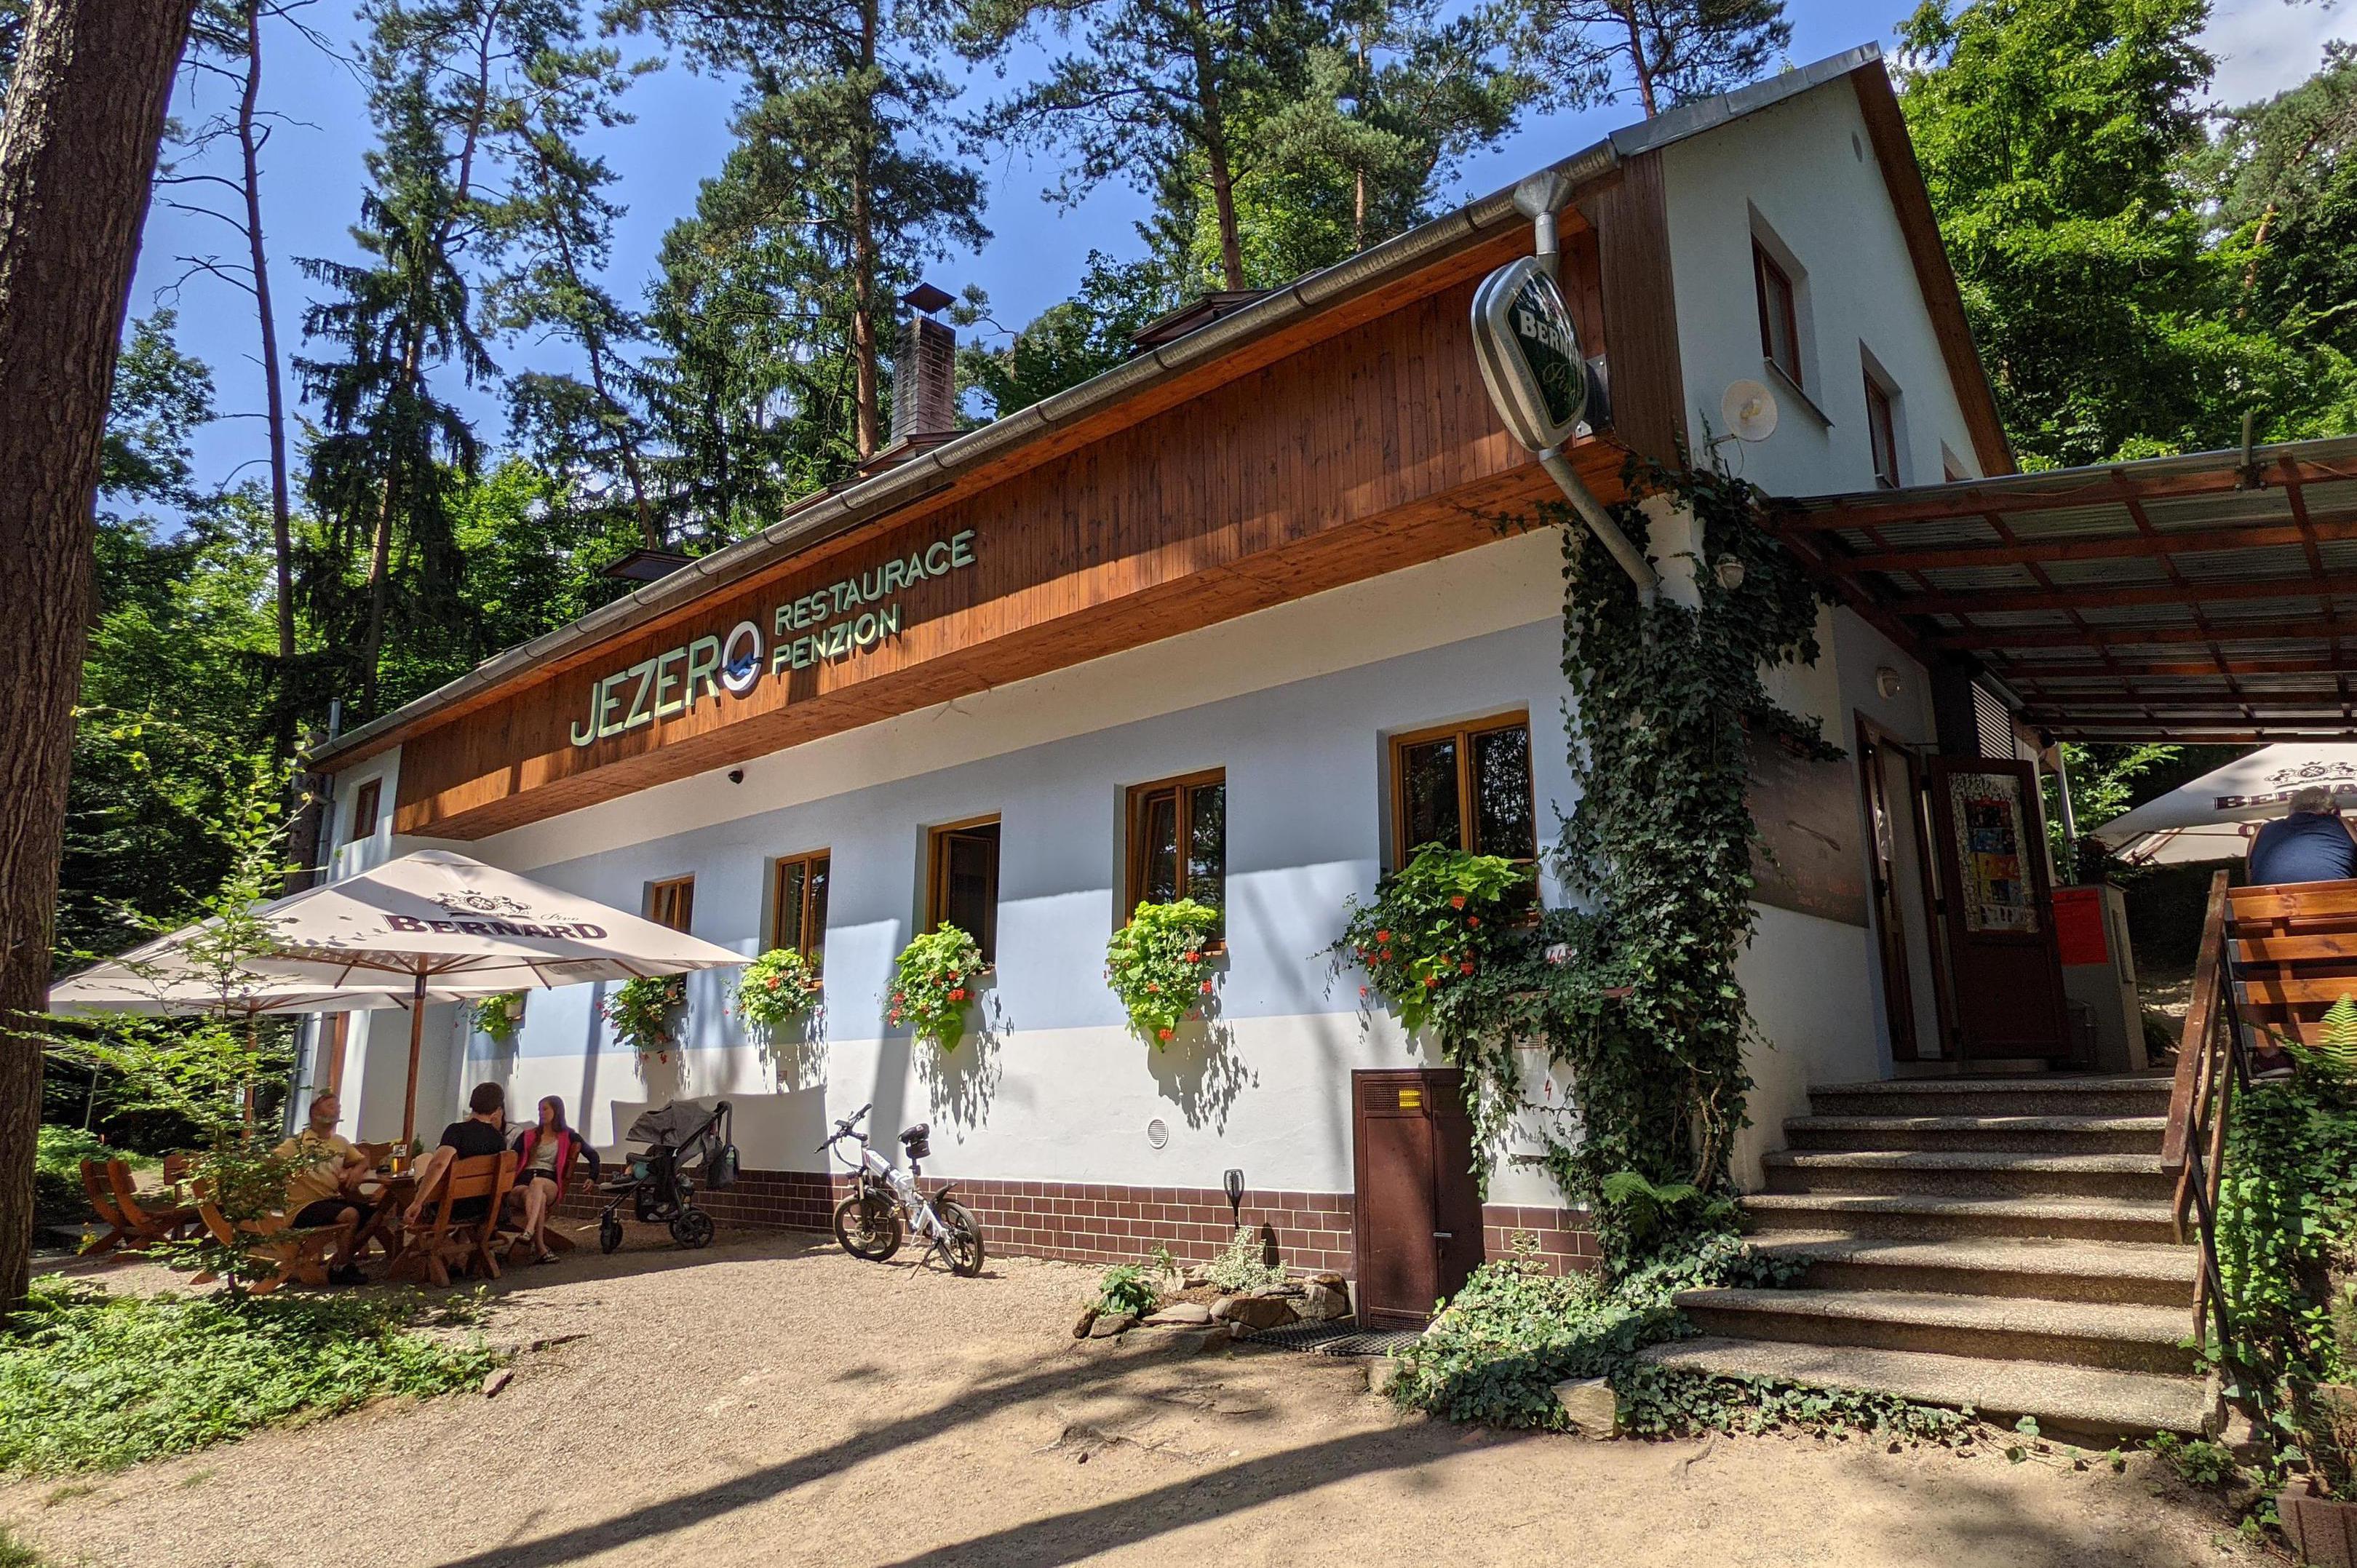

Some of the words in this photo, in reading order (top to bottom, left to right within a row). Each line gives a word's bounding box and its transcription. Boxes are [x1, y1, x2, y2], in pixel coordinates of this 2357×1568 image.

[774, 529, 976, 637] RESTAURACE
[571, 621, 764, 747] JEZERO
[771, 603, 901, 675] PENZION
[380, 914, 608, 939] BERNARD
